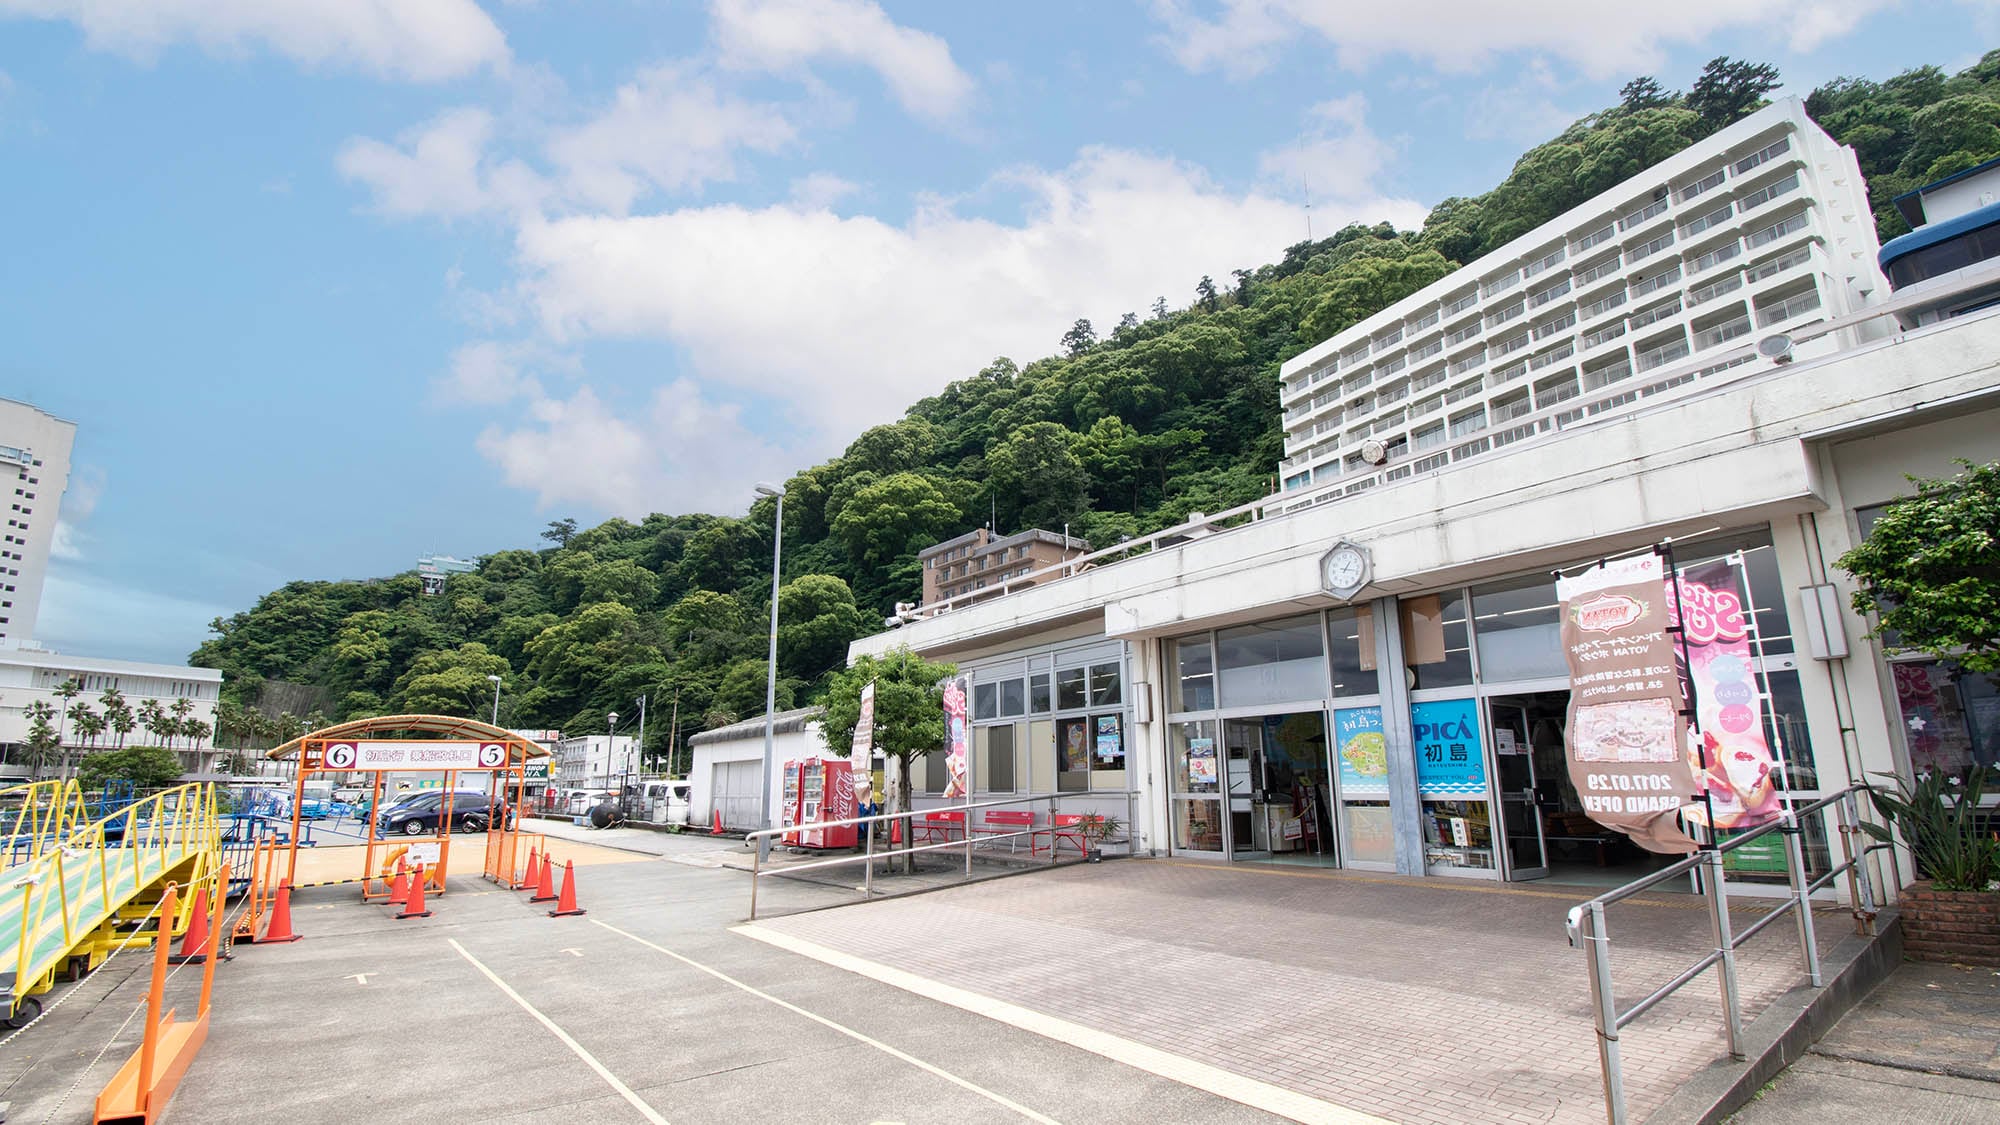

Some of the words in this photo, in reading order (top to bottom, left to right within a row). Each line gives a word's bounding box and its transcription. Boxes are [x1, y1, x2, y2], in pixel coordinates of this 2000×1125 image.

[1414, 714, 1473, 742] PICA
[333, 746, 348, 765] 6
[365, 749, 405, 762] 初島行
[410, 749, 472, 761] 乗船改札口
[486, 747, 499, 764] 5
[1424, 743, 1468, 762] 初島
[500, 769, 541, 777] SAWA
